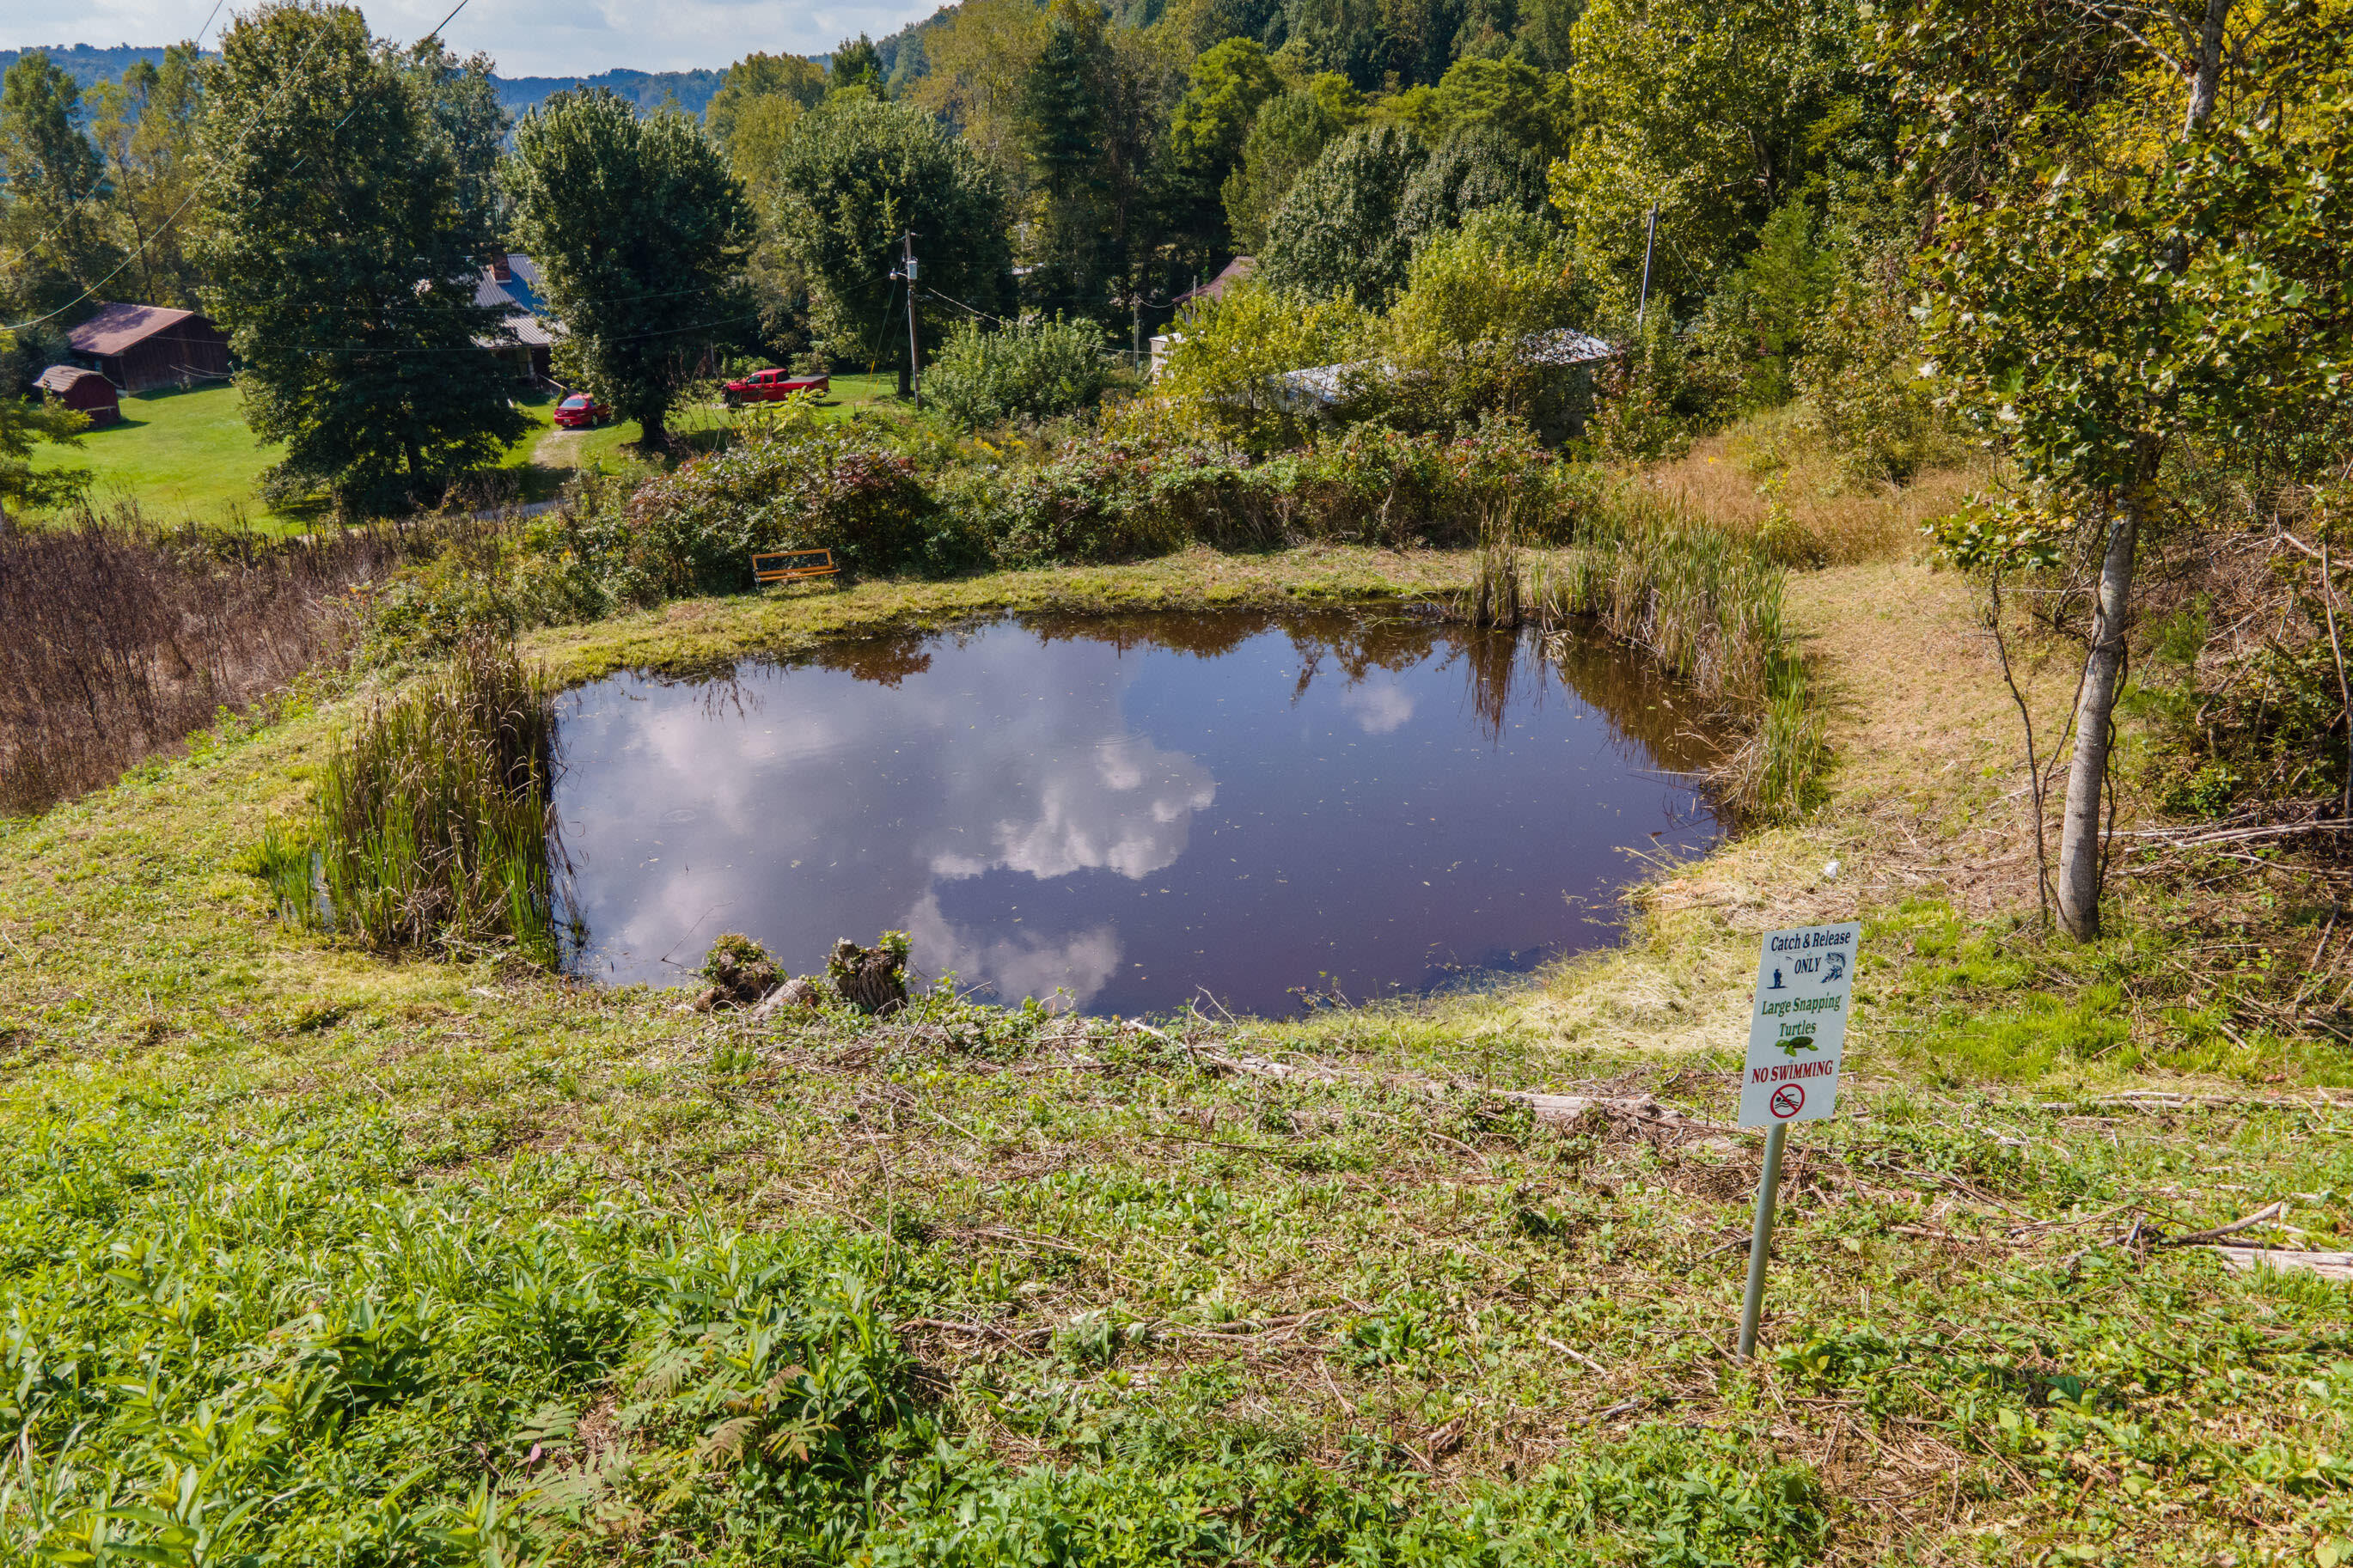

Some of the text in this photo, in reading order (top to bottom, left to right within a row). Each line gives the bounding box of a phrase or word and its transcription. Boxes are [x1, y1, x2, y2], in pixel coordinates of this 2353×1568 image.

[1771, 930, 1851, 951] Catch & Release
[1794, 957, 1821, 974] ONLY
[1762, 992, 1842, 1017] Large Snapping
[1779, 1020, 1816, 1037] Turtles
[1751, 1060, 1834, 1083] NO SWIMMING
